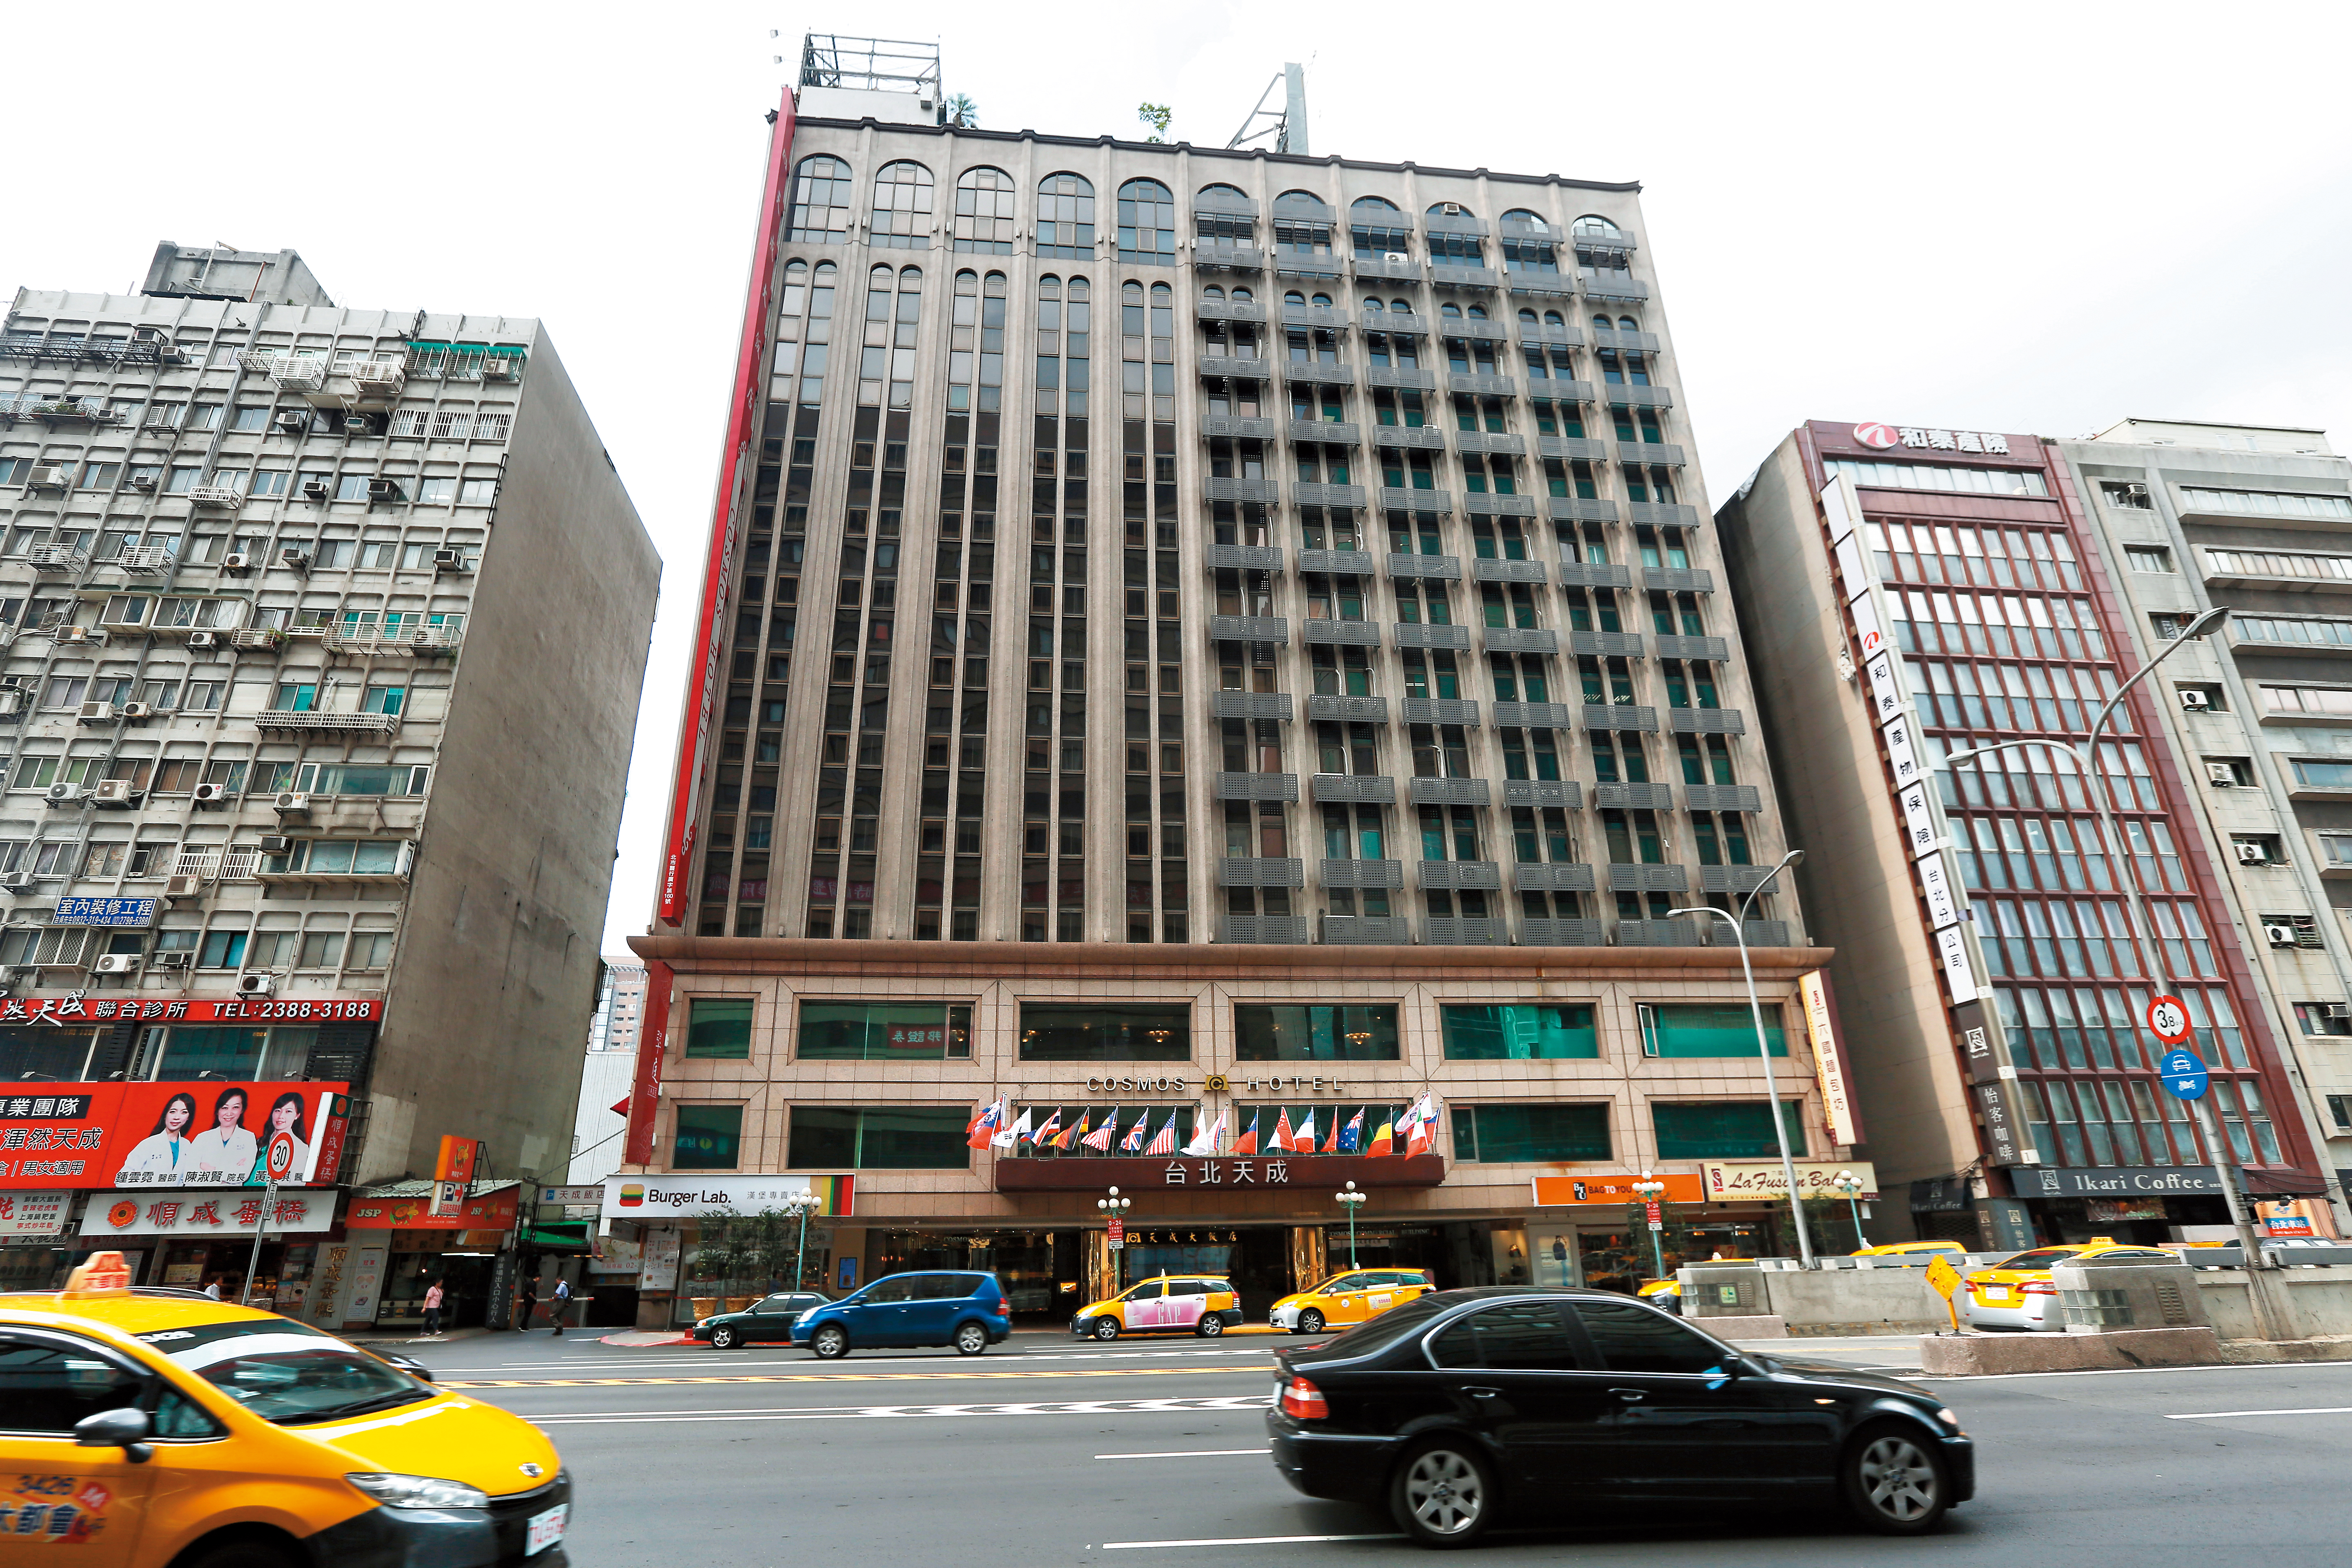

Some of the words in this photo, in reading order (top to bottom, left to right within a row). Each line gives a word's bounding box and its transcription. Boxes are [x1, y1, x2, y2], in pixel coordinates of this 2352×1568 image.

[1899, 427, 2010, 455] 和泰產險
[716, 507, 736, 620] COSMOS
[699, 645, 717, 740] HOTEL
[57, 898, 154, 916] 室內裝修工程
[94, 1001, 189, 1018] 聯合診所
[1087, 1076, 1185, 1092] COSMOS
[1247, 1076, 1343, 1091] HOTEL
[1984, 1088, 2013, 1161] 怡客咖啡
[273, 1145, 287, 1167] 30
[157, 1173, 178, 1183] 醫師
[185, 1171, 223, 1183] 陳淑賢
[227, 1173, 246, 1182] 院長
[1165, 1160, 1289, 1184] 台北天成
[2074, 1174, 2127, 1191] Ikari
[2134, 1173, 2204, 1190] Coffee
[648, 1189, 698, 1207] Burger
[702, 1190, 732, 1203] Lab.
[146, 1199, 307, 1225] 順成蛋糕
[356, 1208, 382, 1218] JSP
[471, 1207, 483, 1215] JSP
[1158, 1306, 1181, 1324] GAP
